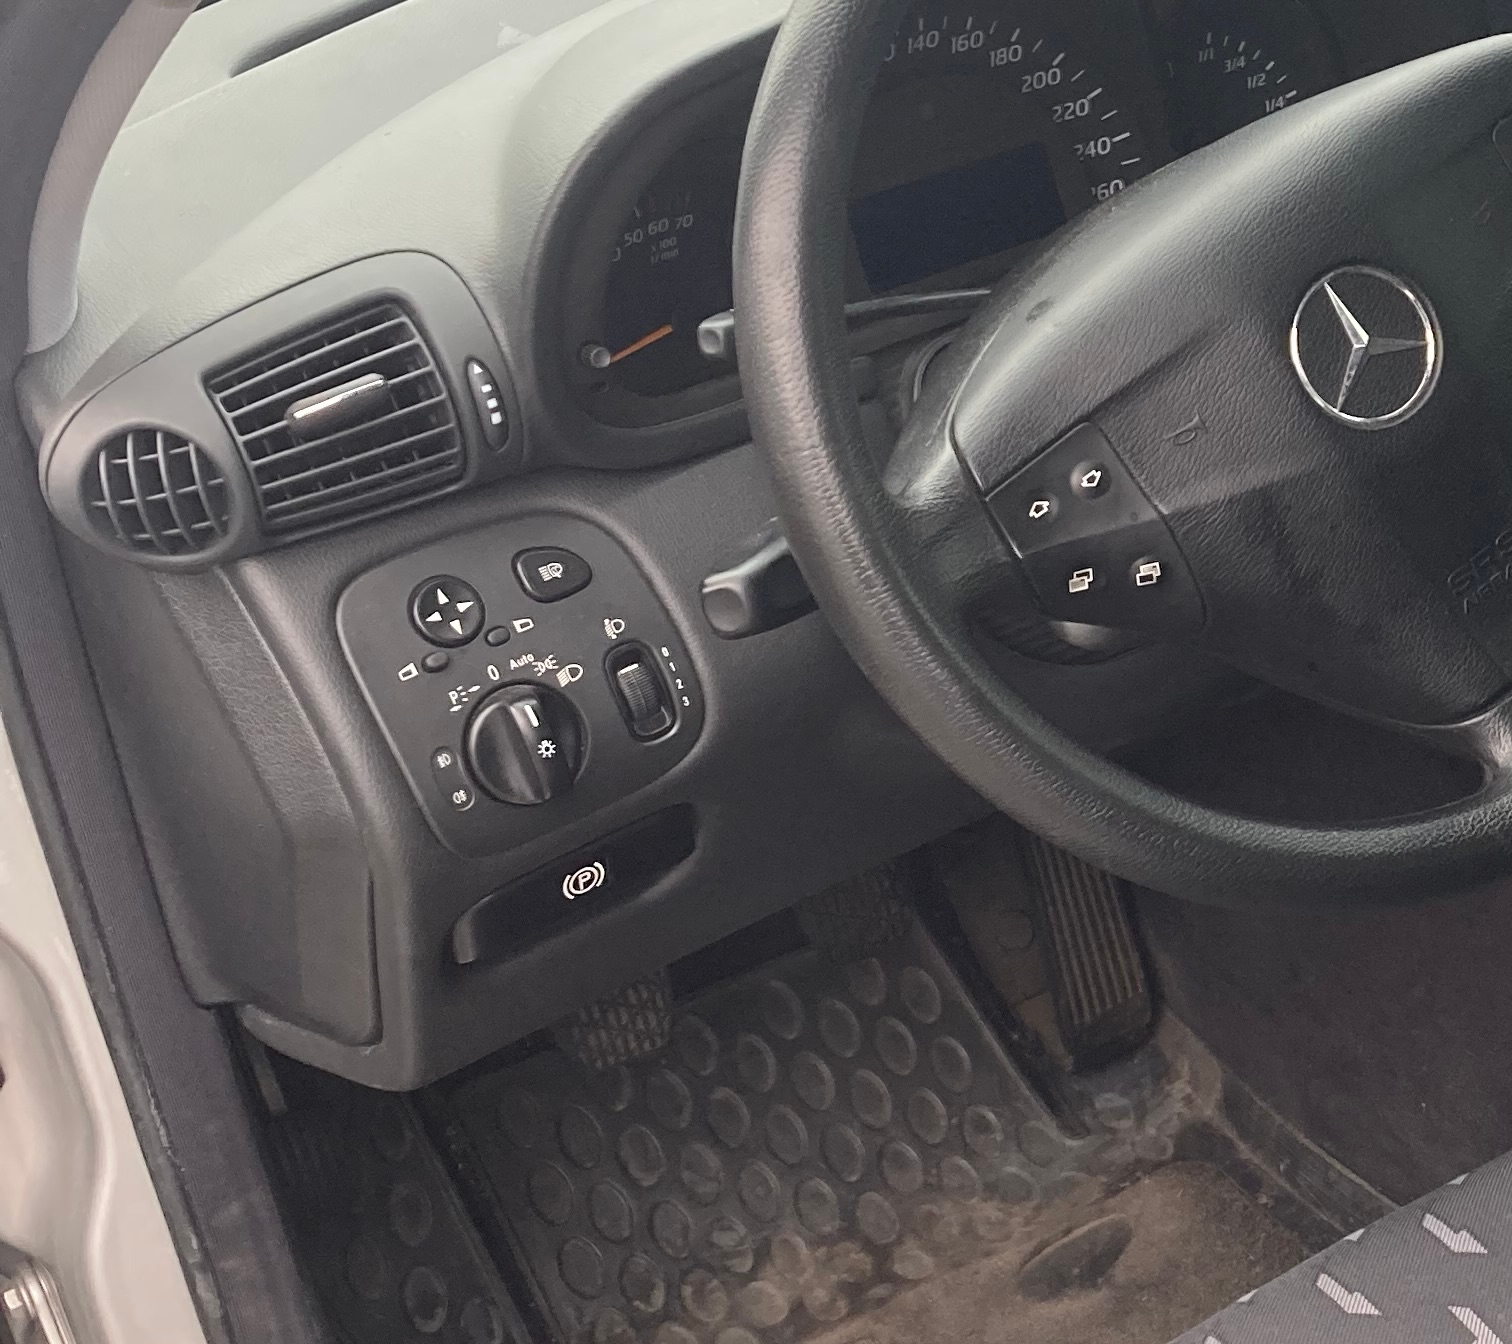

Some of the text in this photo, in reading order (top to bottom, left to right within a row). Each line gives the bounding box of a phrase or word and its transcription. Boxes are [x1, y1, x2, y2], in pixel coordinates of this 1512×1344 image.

[907, 30, 940, 55] 140
[951, 30, 984, 55] 160
[989, 44, 1023, 68] 180
[1224, 56, 1246, 74] 3/4
[1021, 67, 1062, 94] 200
[1247, 72, 1267, 90] 1/2
[1051, 98, 1090, 123] 220
[1265, 95, 1285, 113] 1/4
[647, 218, 670, 236] 60
[674, 214, 694, 231] 70
[623, 228, 644, 248] 50
[510, 653, 535, 671] Auto
[669, 661, 676, 672] 1
[486, 664, 500, 681] 0
[675, 678, 684, 690] 2
[682, 696, 690, 707] 3
